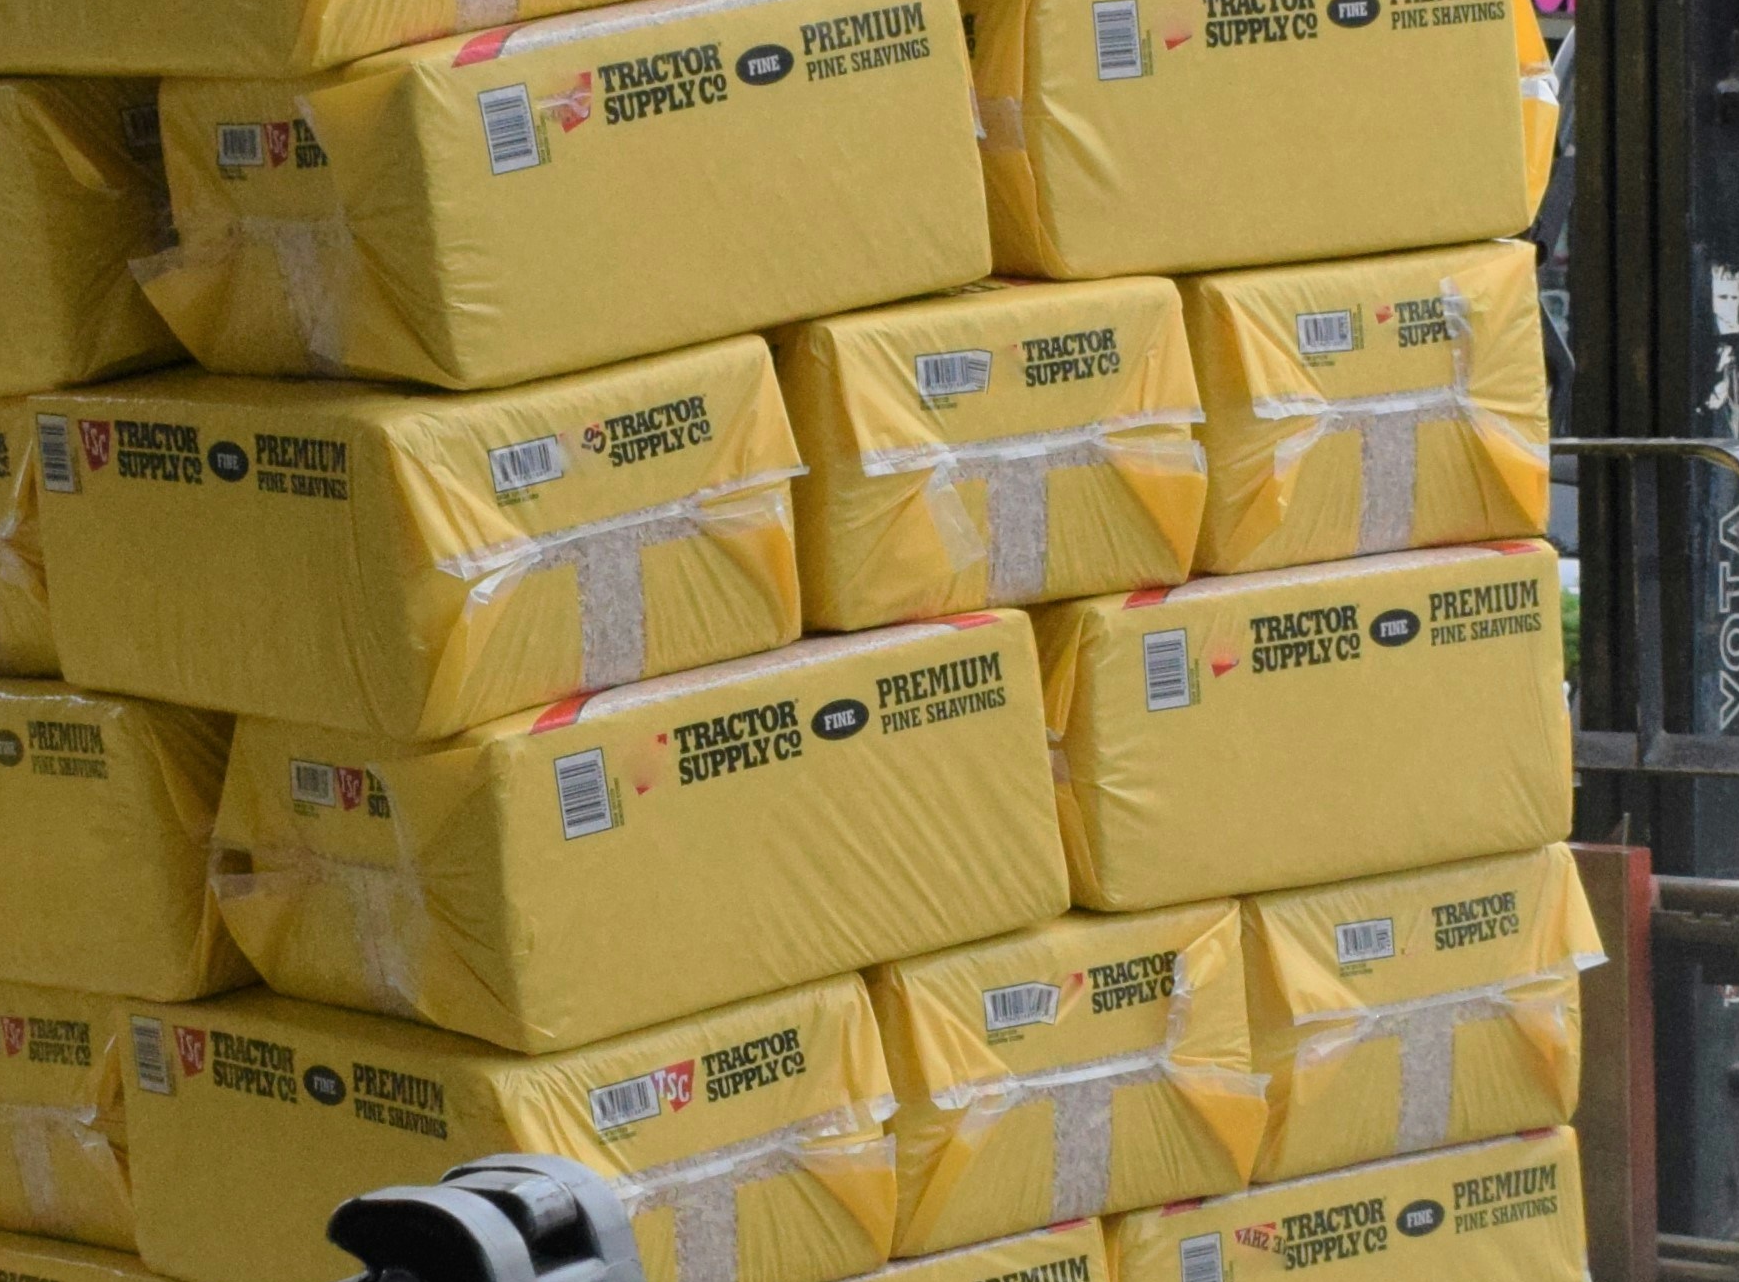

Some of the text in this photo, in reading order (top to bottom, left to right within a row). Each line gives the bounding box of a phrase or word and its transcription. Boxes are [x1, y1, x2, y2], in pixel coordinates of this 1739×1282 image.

[1338, 1, 1367, 18] FINE
[1391, 2, 1505, 30] PINE SHAVINGS
[800, 3, 926, 55] PREMIUM
[1205, 16, 1289, 49] SUPPLY
[598, 44, 722, 94] TRACTOR
[748, 55, 779, 75] FINE
[807, 39, 930, 81] PINE SHAVINGS
[604, 80, 695, 125] SUPPLY
[1395, 297, 1443, 325] TRAC
[1023, 328, 1116, 362] TRACTOR
[1025, 359, 1094, 388] SUPPLY
[605, 394, 706, 441] TRACTOR
[115, 421, 200, 456] TRACTOR
[255, 434, 347, 473] PREMIUM
[609, 428, 683, 468] SUPPLY
[117, 453, 181, 482] SUPPLY
[218, 454, 239, 469] FINE
[258, 470, 348, 501] PINE SHAVINGS
[1429, 580, 1539, 621] PREMIUM
[1251, 605, 1357, 645] TRACTOR
[1381, 618, 1408, 636] FINE
[1430, 613, 1542, 646] PINE SHAVINGS
[1253, 638, 1332, 673] SUPPLY
[876, 653, 1002, 708] PREMIUM
[674, 701, 797, 755] TRACTOR
[824, 708, 856, 730] FINE
[881, 688, 1006, 734] PINE SHAVINGS
[29, 721, 104, 754] PREMIUM
[678, 738, 770, 786] SUPPLY
[1433, 893, 1516, 928] TRACTOR
[1435, 922, 1495, 951] SUPPLY
[1088, 950, 1176, 994] TRACTOR
[1091, 978, 1158, 1014] SUPPLY
[29, 1019, 89, 1045] TRACTOR
[29, 1042, 74, 1063] SUPPLY
[212, 1032, 295, 1074] TRACTOR
[702, 1029, 799, 1078] TRACTOR
[213, 1059, 276, 1098] SUPPLY
[313, 1077, 336, 1094] FINE
[353, 1064, 444, 1115] PREMIUM
[655, 1063, 691, 1104] TSC
[707, 1064, 777, 1103] SUPPLY
[354, 1100, 447, 1140] PINE SHAVINGS
[1453, 1165, 1556, 1209] PREMIUM
[1282, 1199, 1384, 1242] TRACTOR
[1406, 1210, 1433, 1227] FINE
[1455, 1197, 1558, 1234] PINE SHAVINGS
[1285, 1232, 1360, 1270] SUPPLY
